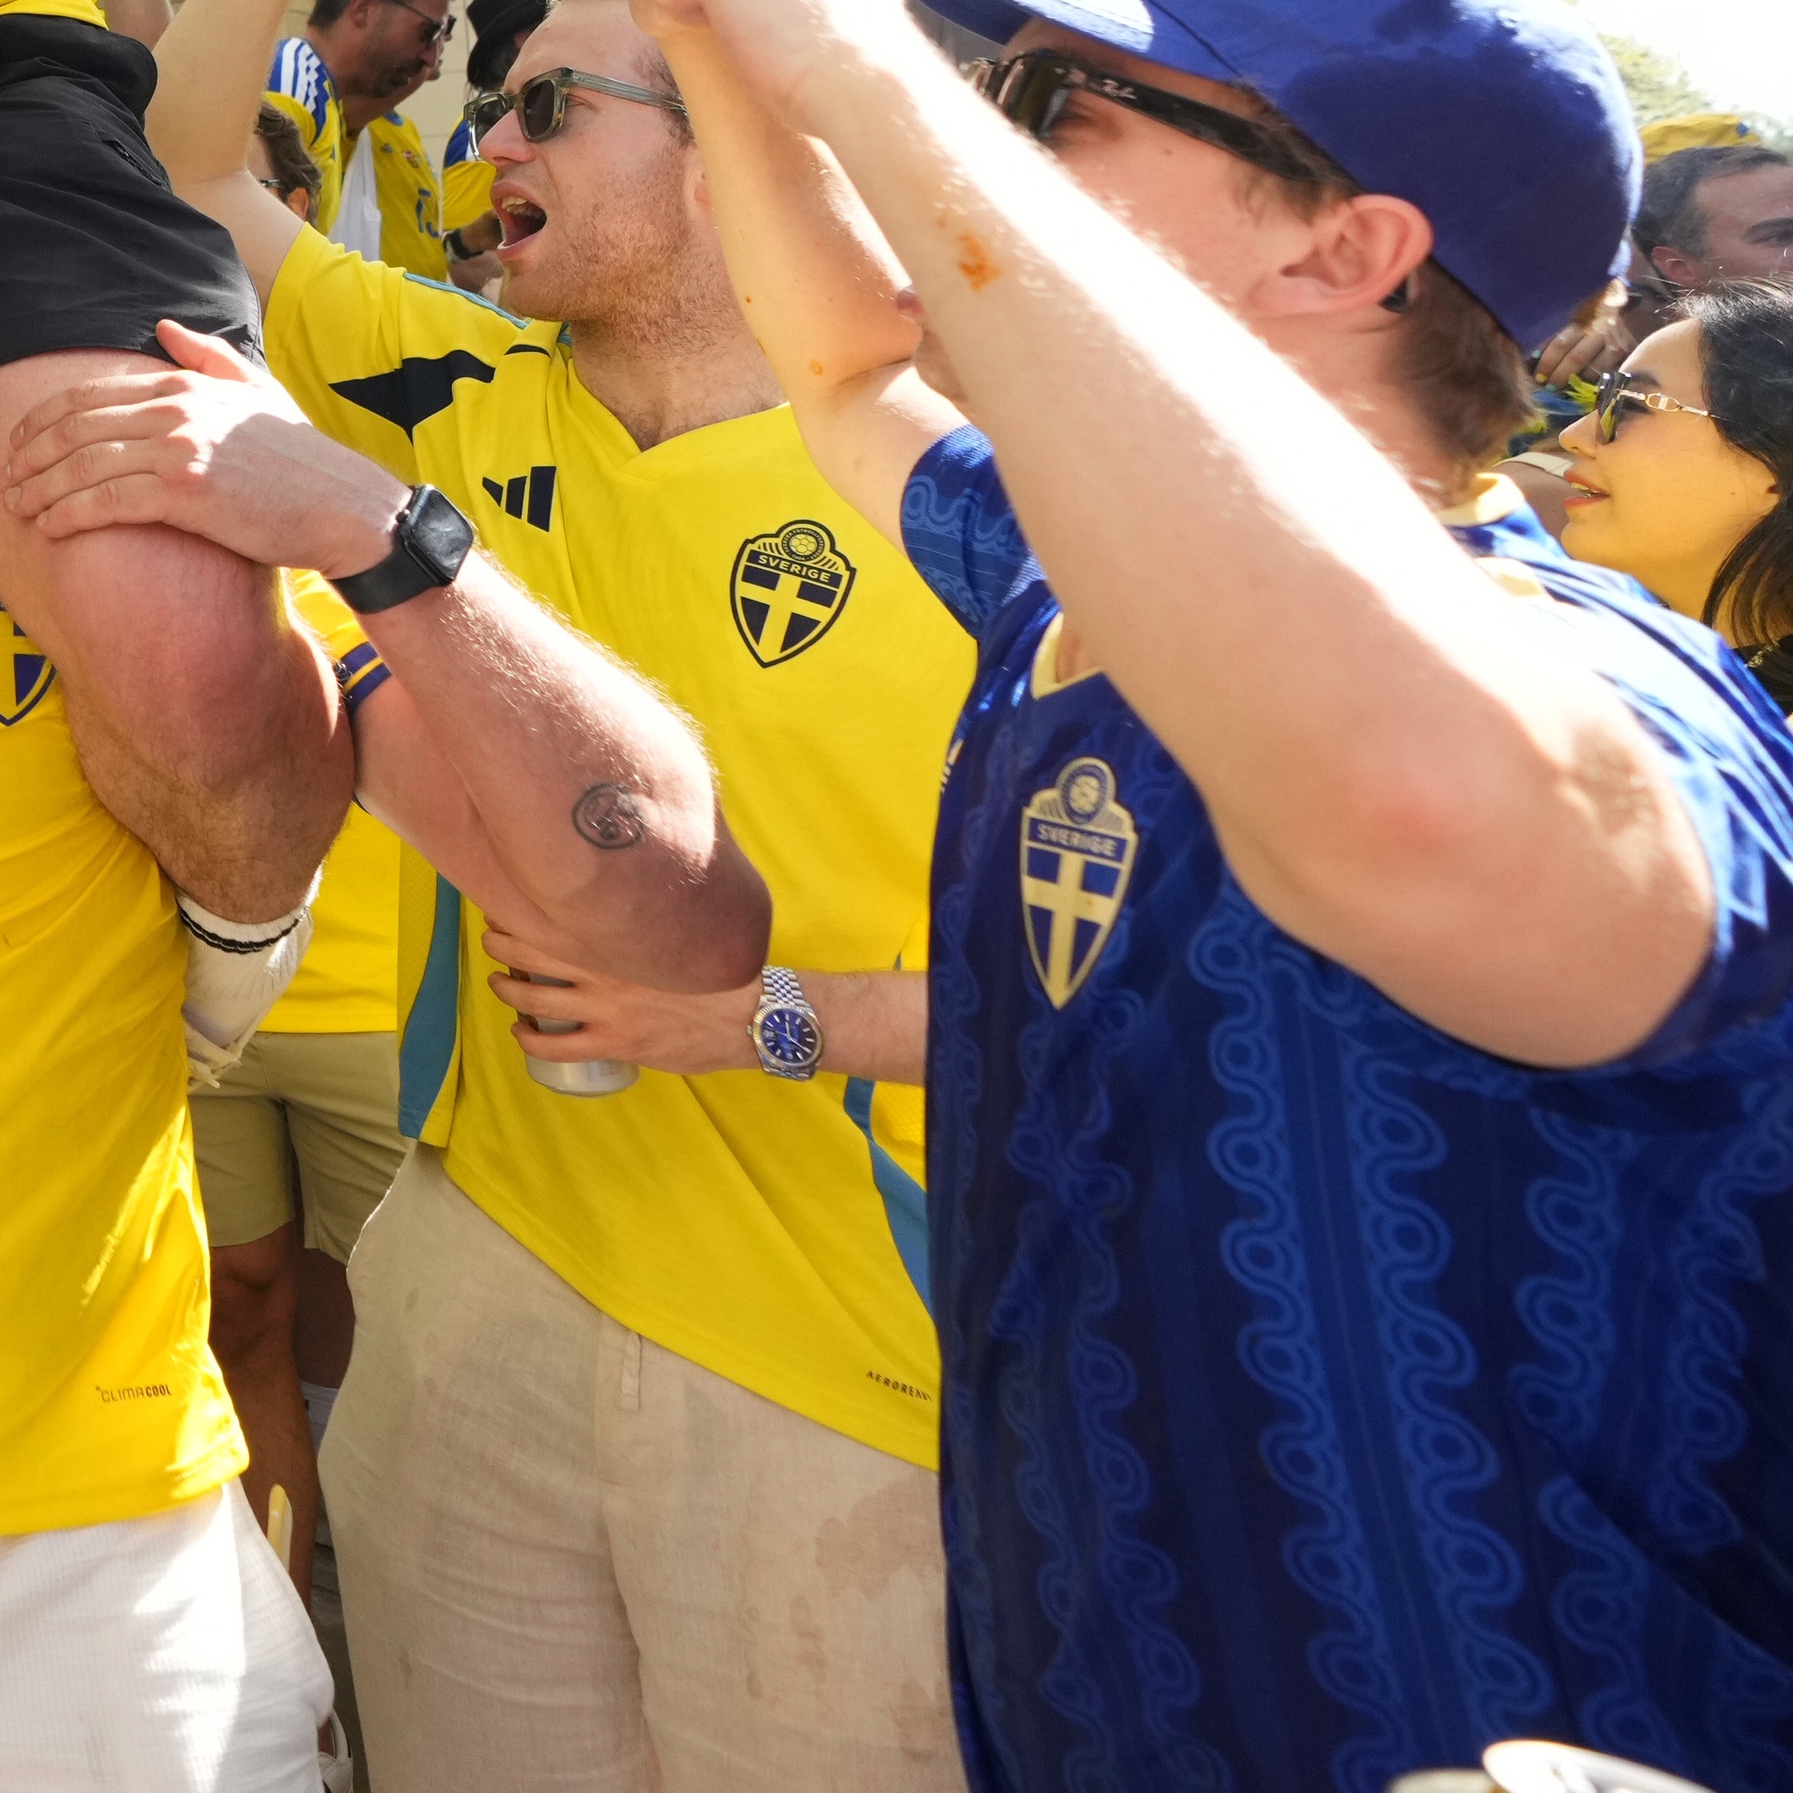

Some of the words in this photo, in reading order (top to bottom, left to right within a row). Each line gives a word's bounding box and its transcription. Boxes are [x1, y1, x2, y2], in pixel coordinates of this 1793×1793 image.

[758, 554, 831, 583] SVERIGE
[1037, 823, 1117, 857] SVERIGE
[100, 1383, 172, 1403] CLIMACOOL
